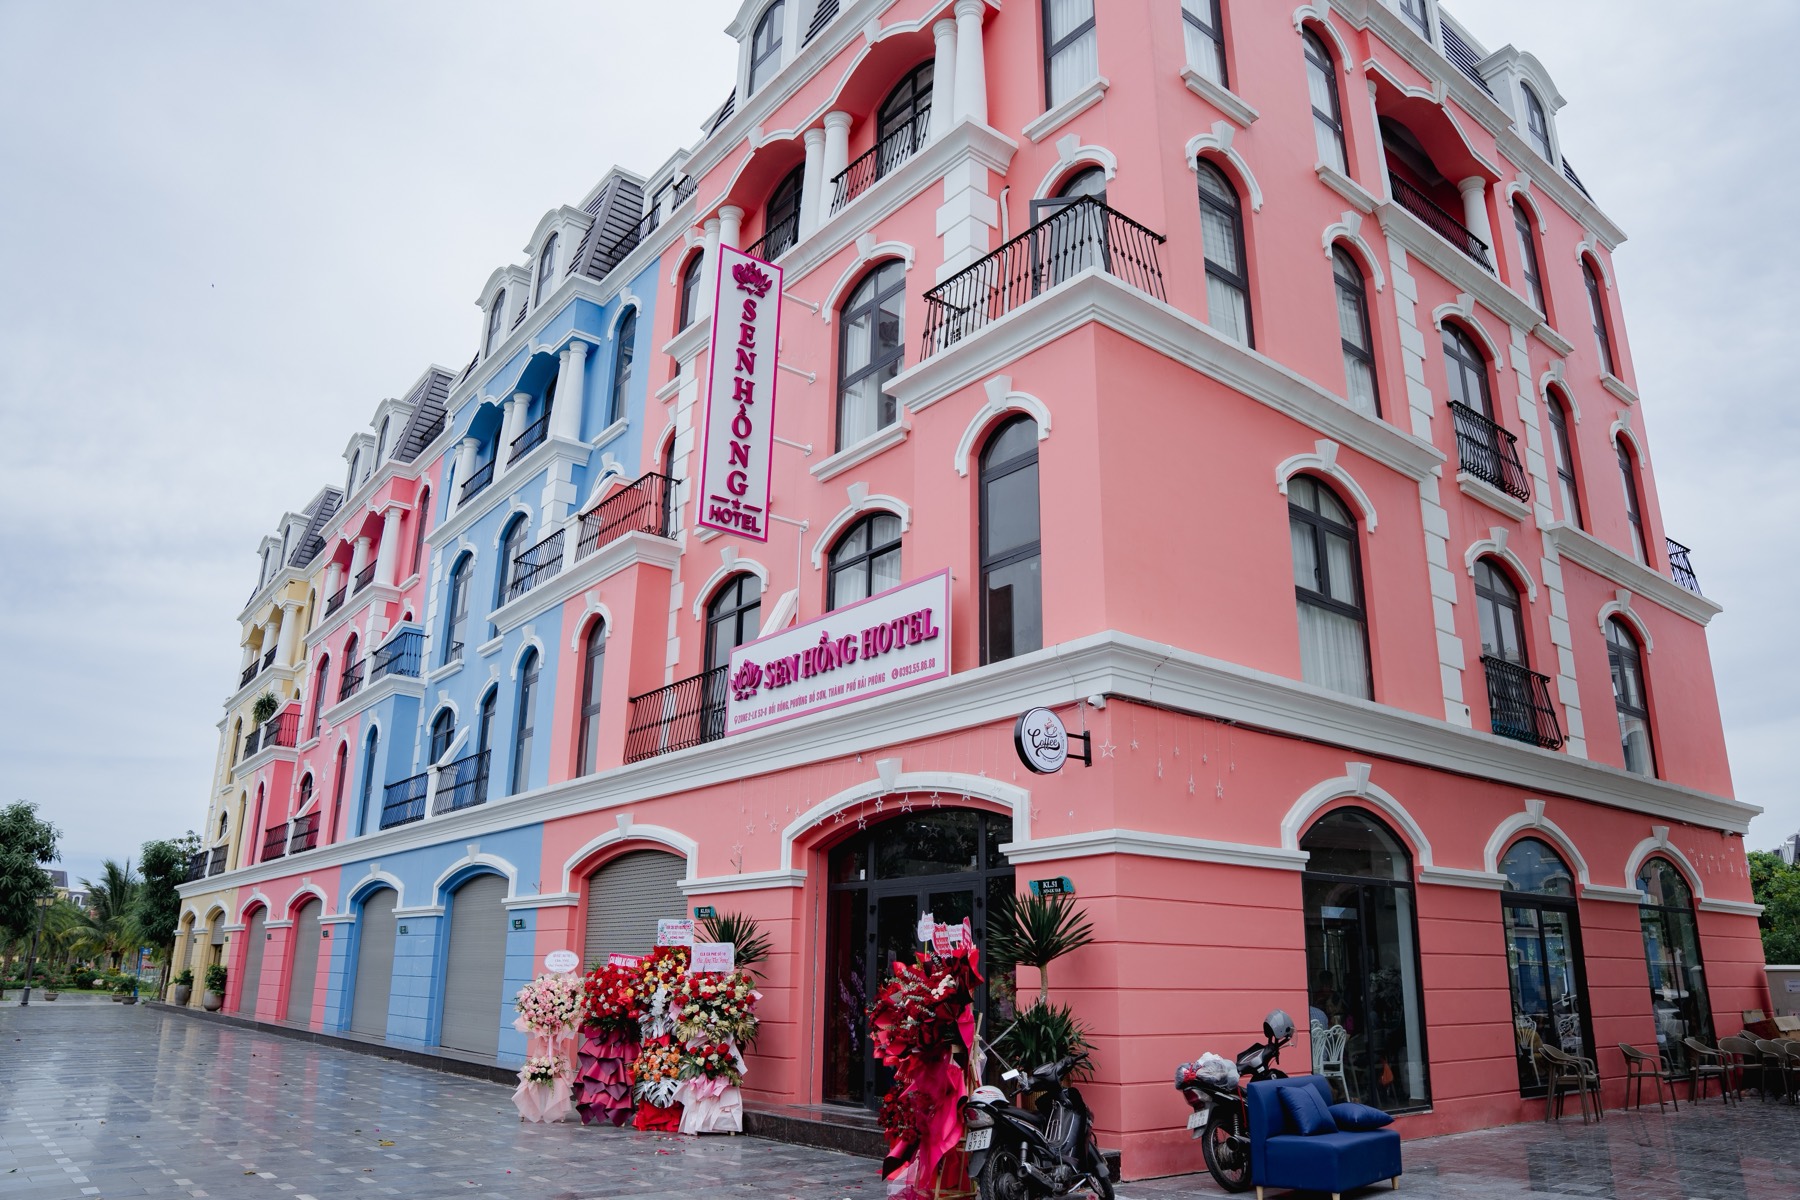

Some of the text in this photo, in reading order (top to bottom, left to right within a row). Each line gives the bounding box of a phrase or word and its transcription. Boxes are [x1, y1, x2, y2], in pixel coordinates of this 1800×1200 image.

[709, 504, 762, 533] HOTEL
[763, 608, 938, 690] SEN HỒNG HOTEL
[828, 683, 845, 698] THÀNH
[857, 675, 867, 690] HẢI
[867, 672, 886, 688] PHÒNG
[1027, 728, 1060, 757] Coffee
